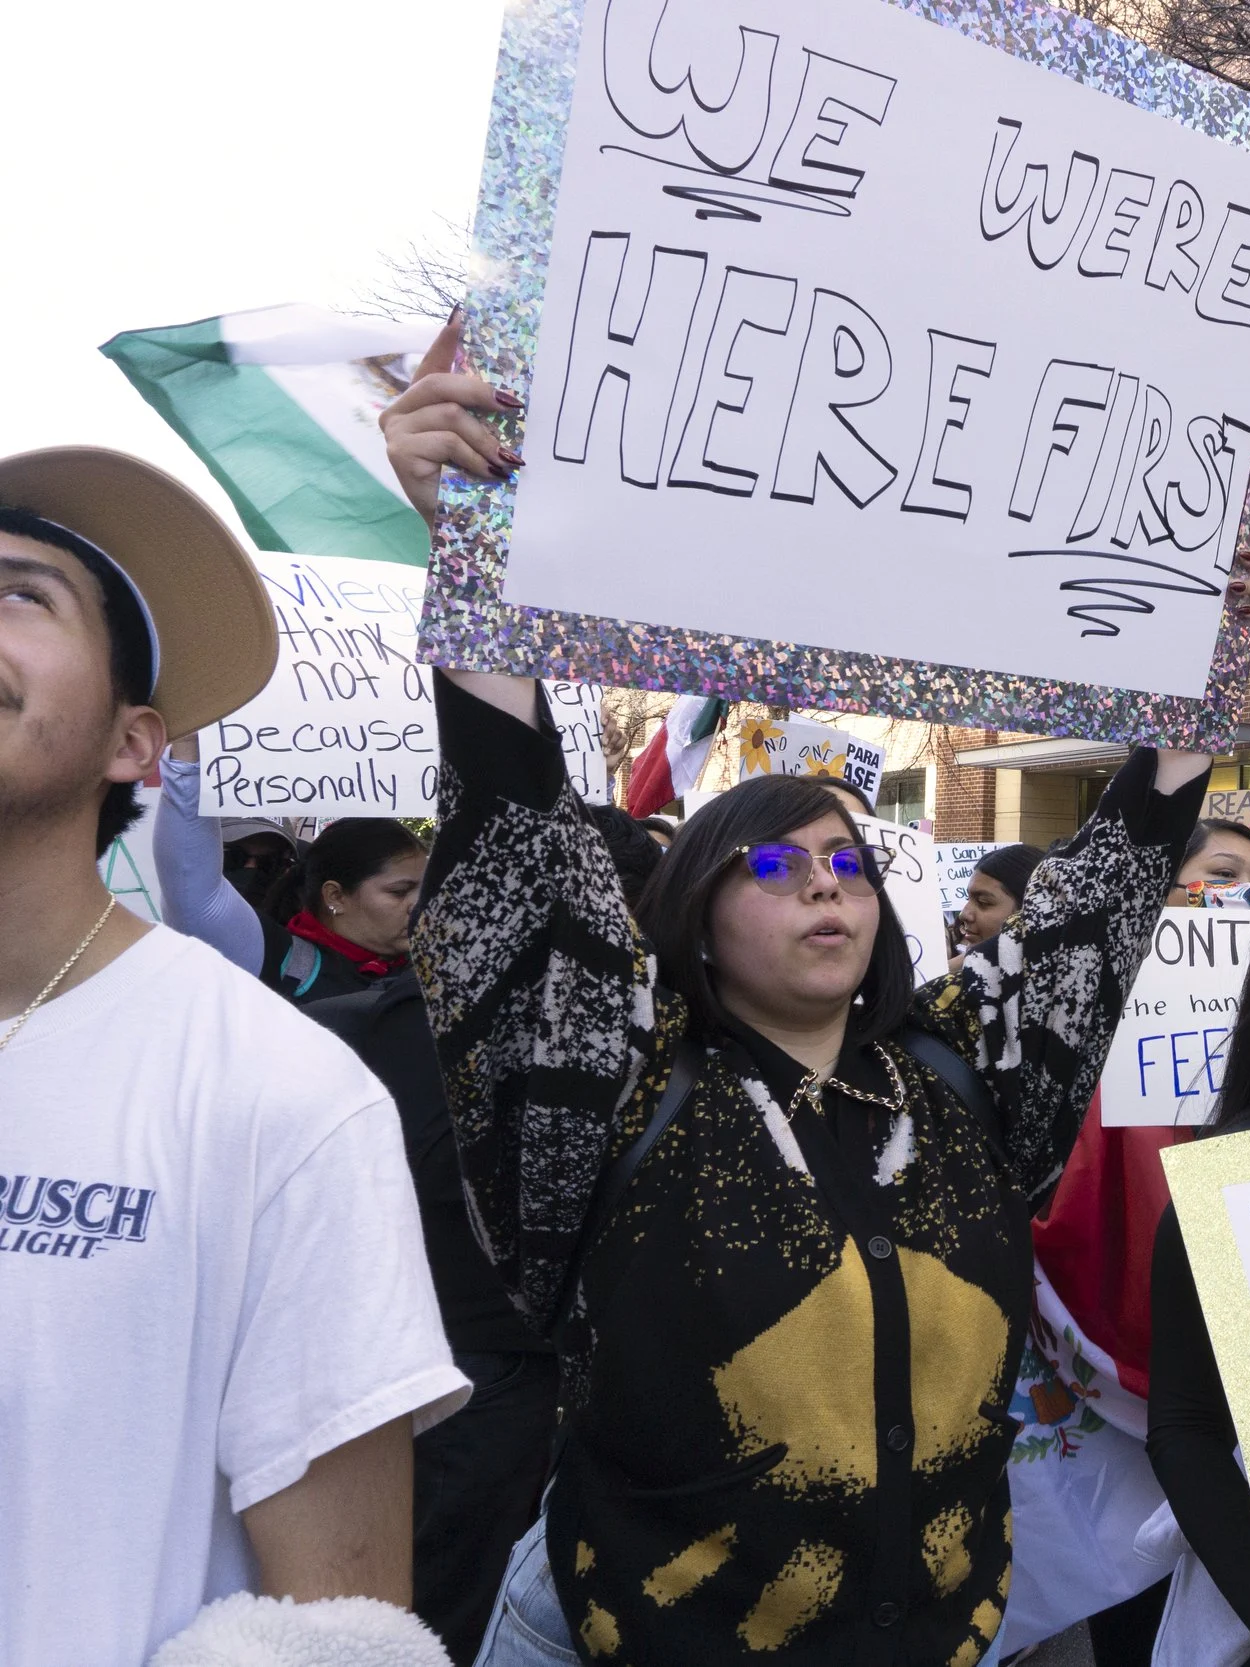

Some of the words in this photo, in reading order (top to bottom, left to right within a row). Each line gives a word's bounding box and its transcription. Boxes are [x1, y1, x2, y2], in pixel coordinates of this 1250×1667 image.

[602, 0, 897, 198] WE
[552, 231, 997, 523] HERE
[276, 605, 412, 666] think
[292, 658, 381, 702] not
[219, 719, 434, 754] because
[764, 735, 788, 754] NO
[798, 744, 834, 764] ONE
[846, 743, 880, 769] PARA
[206, 755, 398, 812] Personally
[951, 845, 987, 860] Can't
[1144, 917, 1250, 968] ONT
